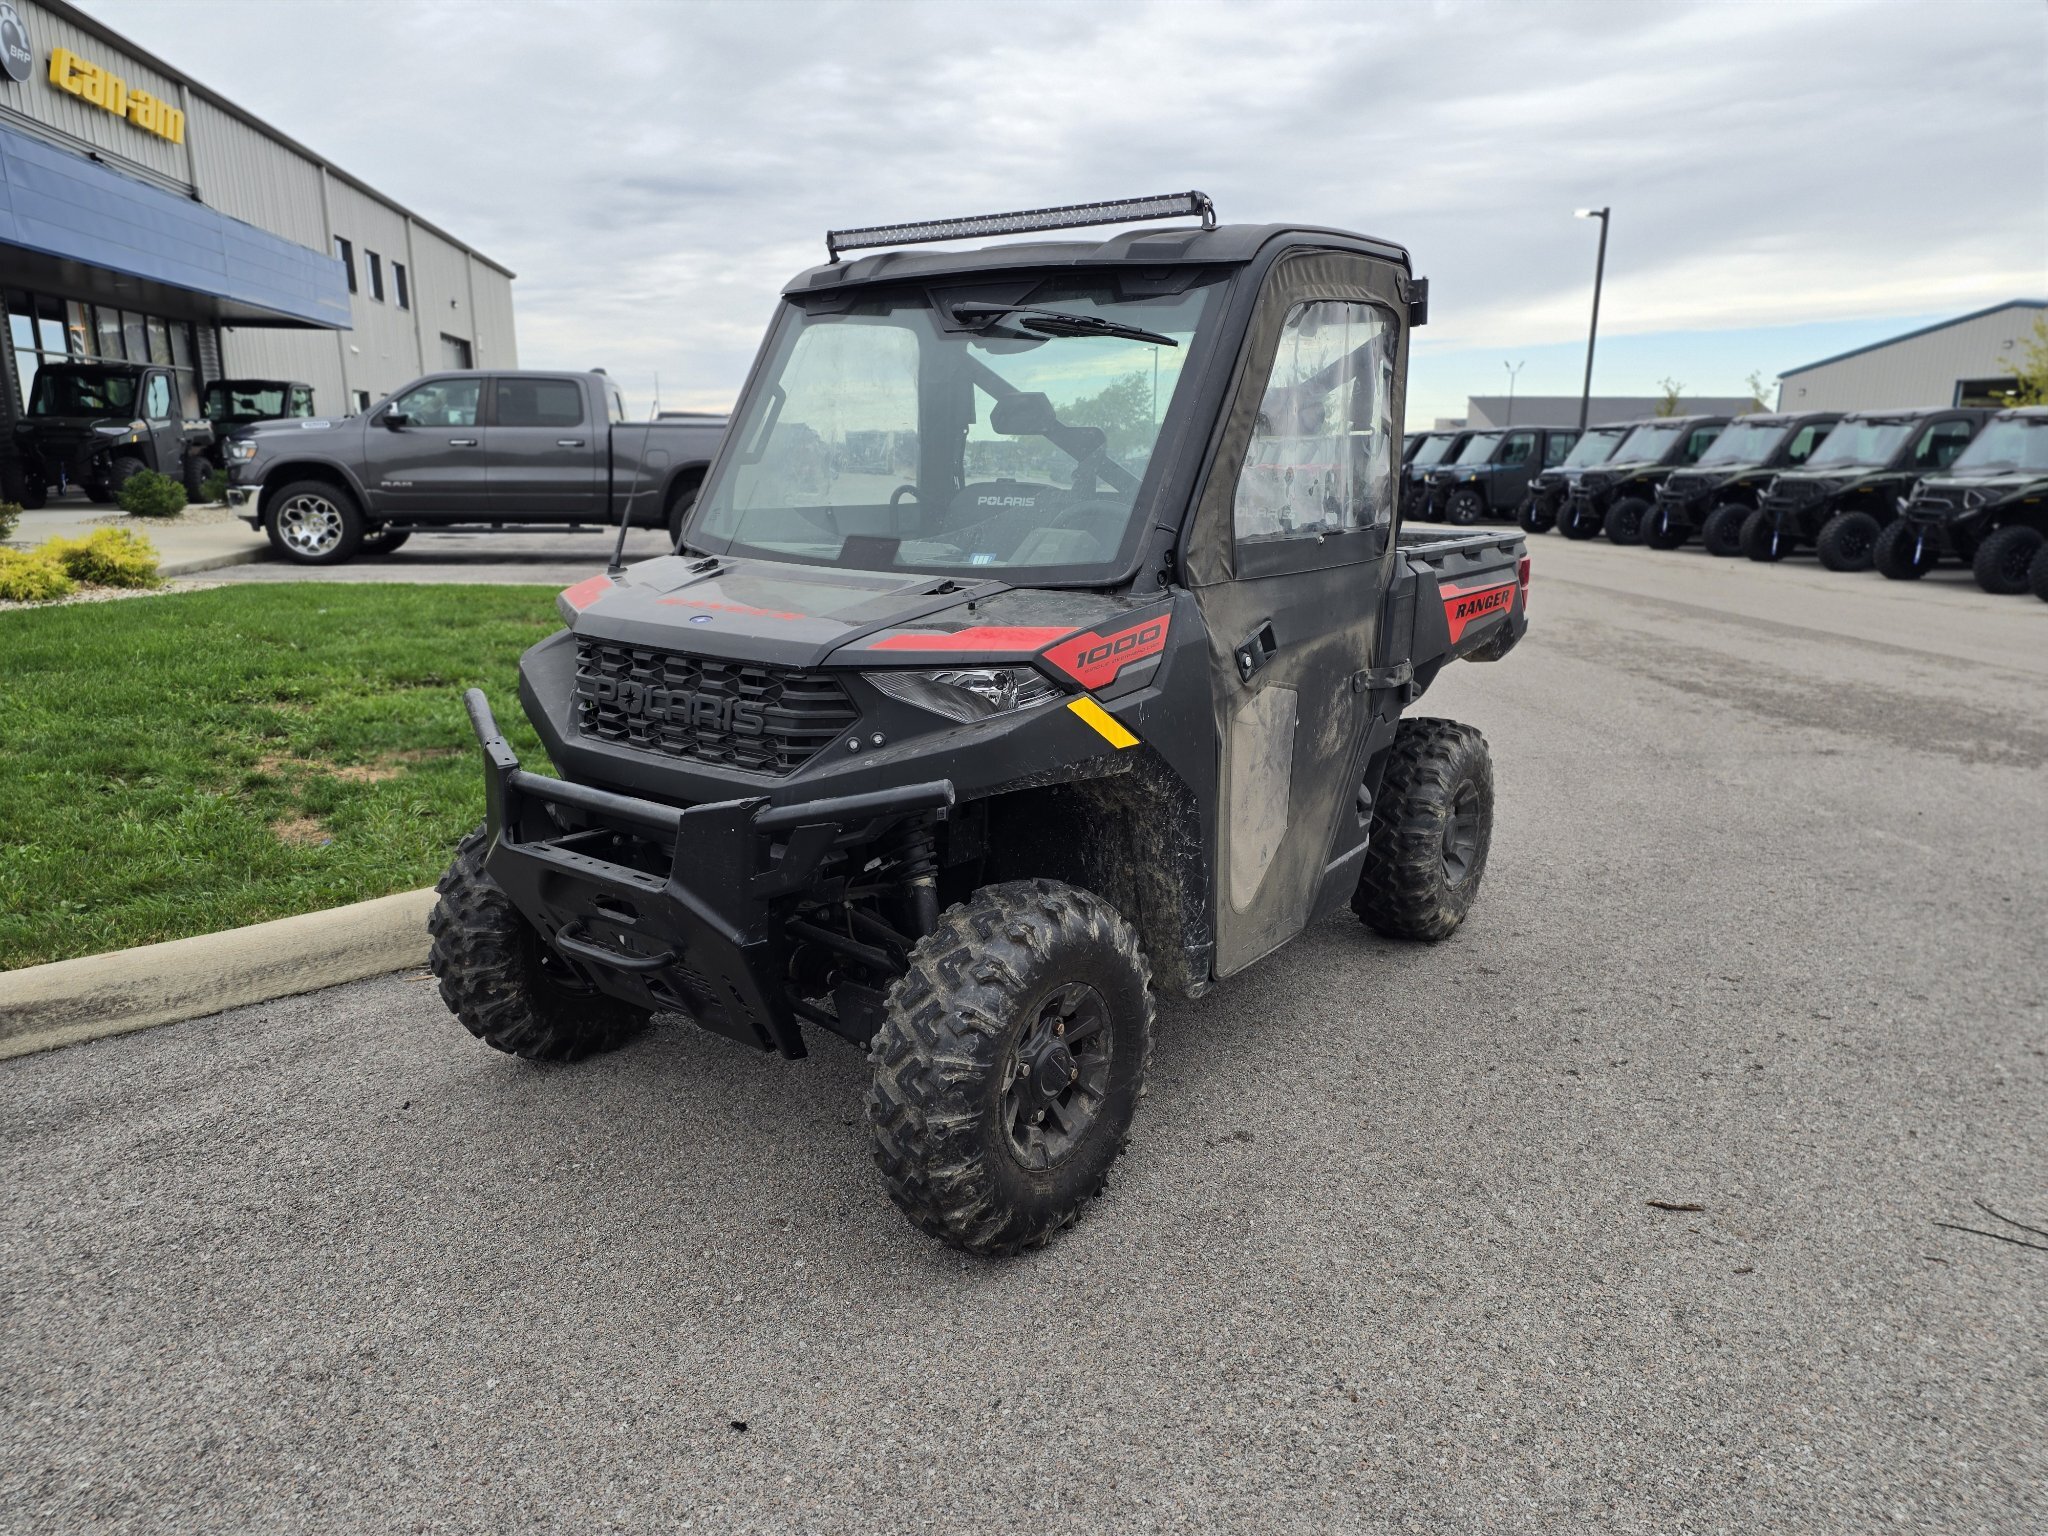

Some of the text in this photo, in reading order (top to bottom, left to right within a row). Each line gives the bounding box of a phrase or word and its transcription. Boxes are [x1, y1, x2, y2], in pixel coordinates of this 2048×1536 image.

[10, 45, 31, 64] BRP
[50, 47, 184, 145] can-am
[977, 496, 1035, 507] POLARIS
[1455, 590, 1510, 619] RANGER
[1077, 624, 1161, 668] 1000
[594, 675, 765, 736] POLARIS
